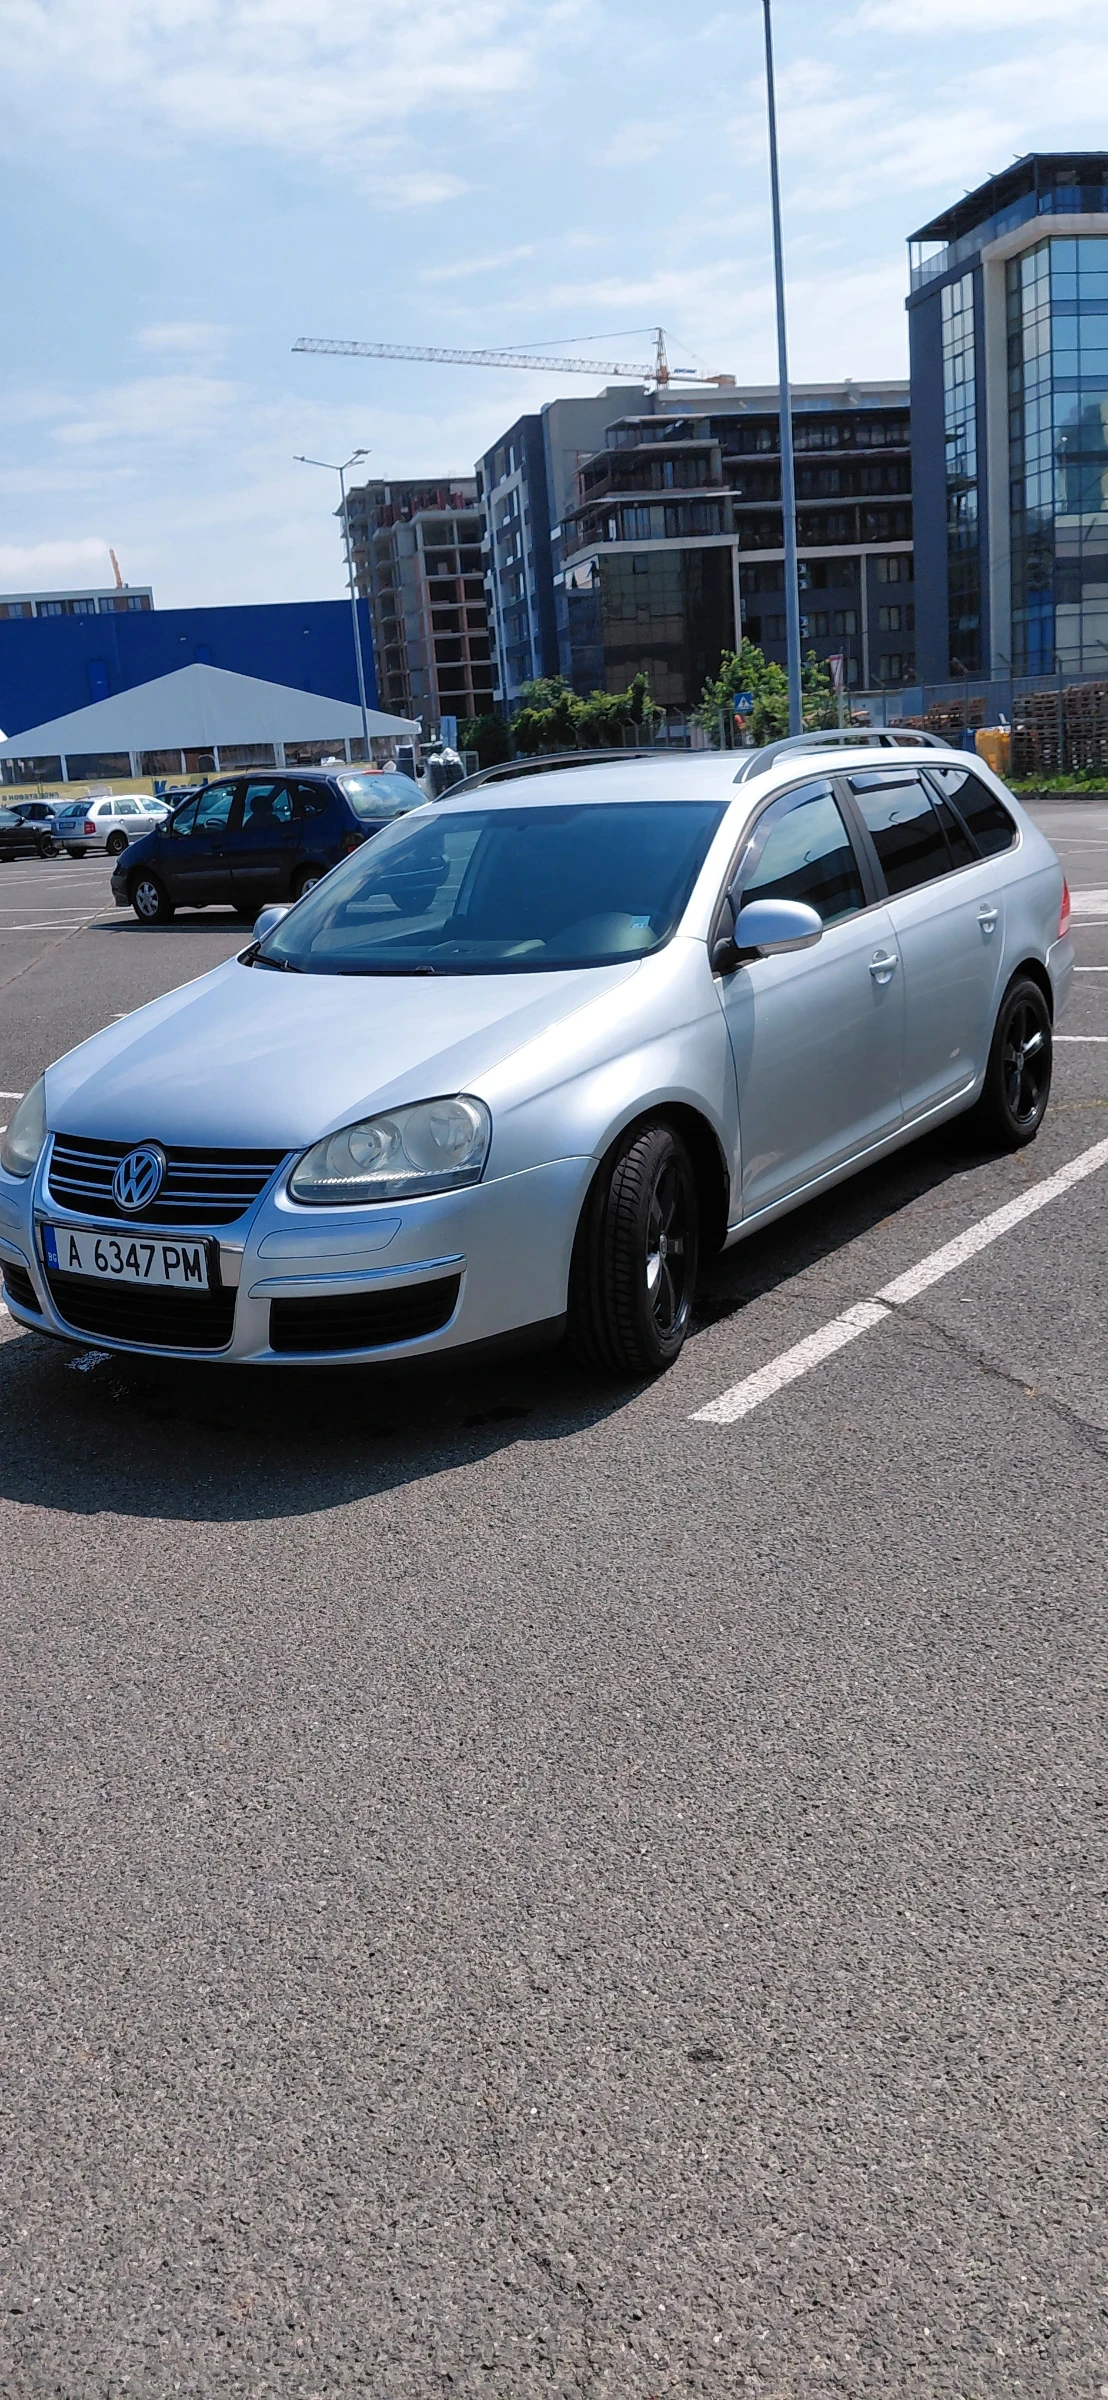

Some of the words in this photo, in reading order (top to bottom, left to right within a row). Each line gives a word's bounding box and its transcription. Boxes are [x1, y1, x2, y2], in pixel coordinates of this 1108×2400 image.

[47, 1251, 57, 1263] BG
[68, 1234, 83, 1269] A
[94, 1239, 156, 1278] 6347
[162, 1246, 203, 1283] PM
